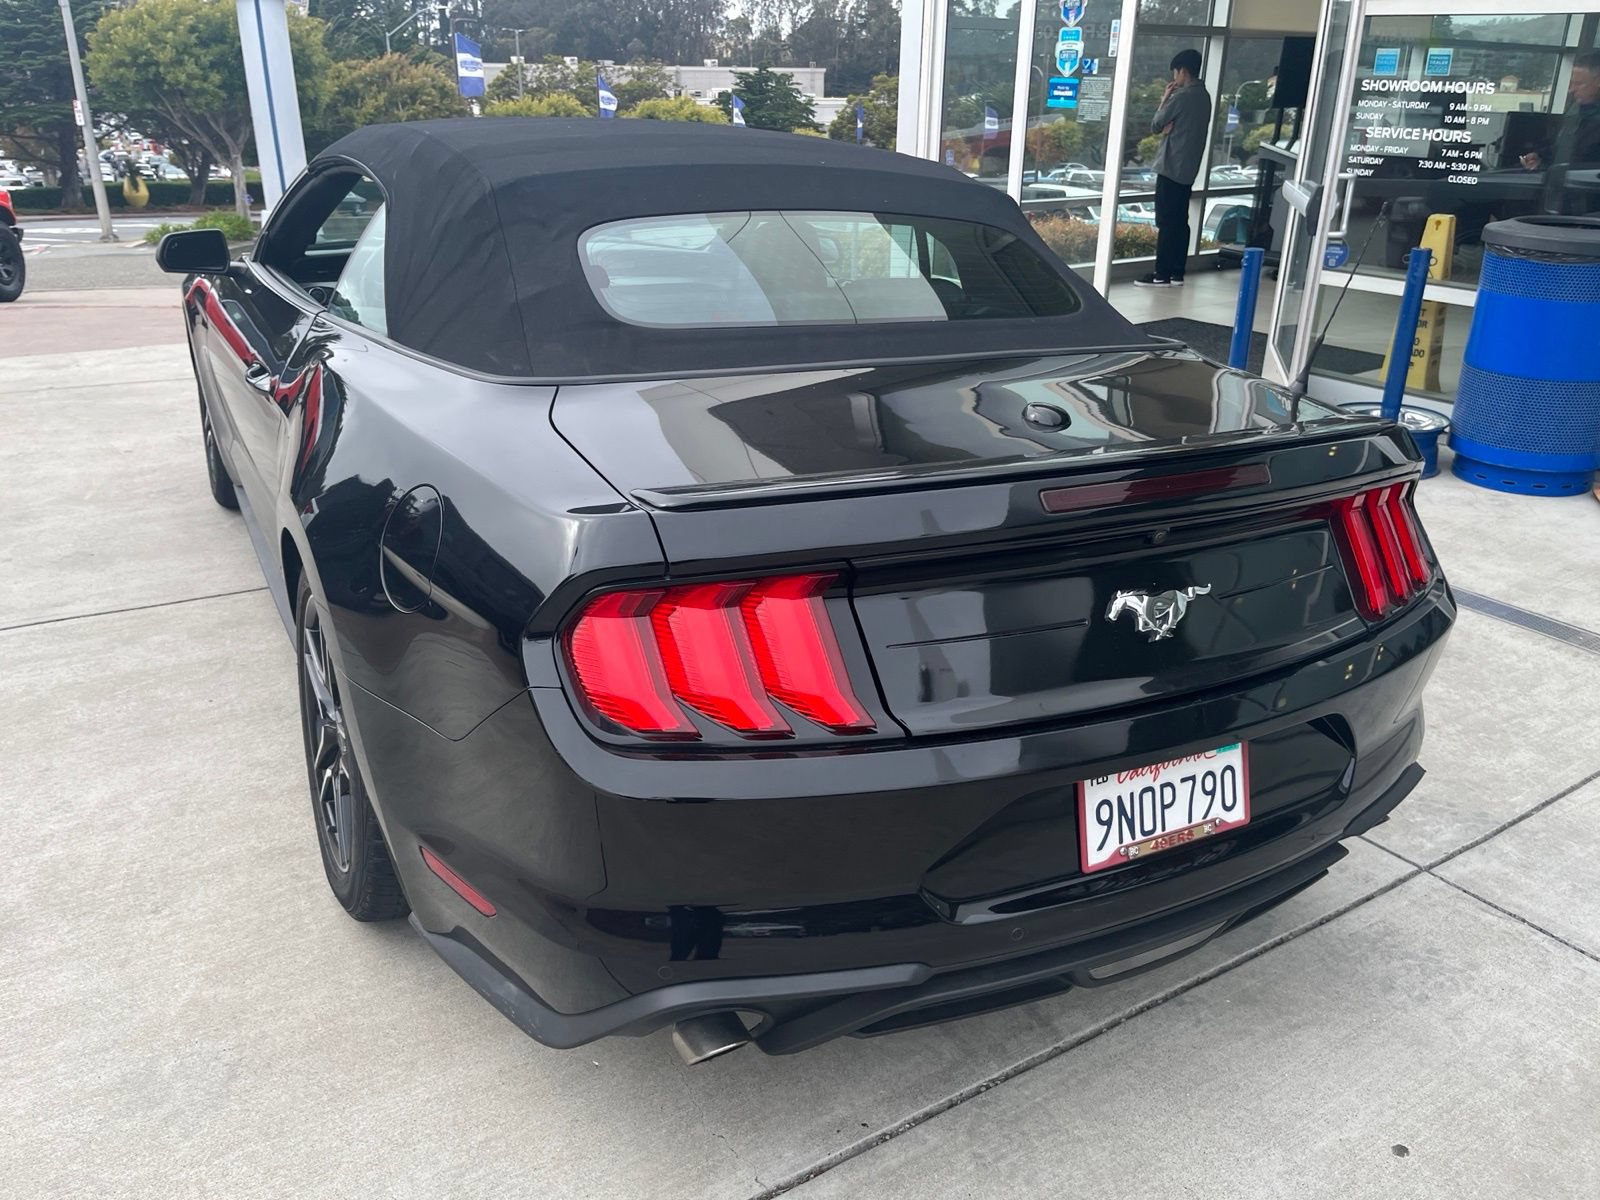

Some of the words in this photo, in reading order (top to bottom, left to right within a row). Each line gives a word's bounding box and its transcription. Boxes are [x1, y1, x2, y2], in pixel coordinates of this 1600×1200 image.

[1361, 79, 1441, 93] SHOWROOM
[1445, 82, 1495, 95] HOURS
[1358, 100, 1387, 108] MONDAY
[1392, 101, 1430, 109] SATURDAY
[1449, 103, 1454, 111] 9
[1455, 103, 1468, 111] AM
[1480, 104, 1492, 112] PM
[1355, 112, 1383, 120] SUNDAY
[1444, 115, 1451, 123] 10
[1453, 115, 1465, 124] AM
[1470, 117, 1476, 125] 8
[1477, 117, 1490, 125] PM
[1365, 126, 1420, 140] SERVICE
[1422, 128, 1472, 143] HOURS
[1350, 144, 1379, 152] MONDAY
[1384, 145, 1408, 154] FRIDAY
[1441, 149, 1446, 157] 7
[1447, 149, 1459, 158] AM
[1470, 151, 1482, 160] PM
[1348, 156, 1384, 165] SATURDAY
[1418, 160, 1433, 168] 7:30
[1433, 161, 1446, 170] AM
[1451, 162, 1467, 171] 5:30
[1468, 163, 1480, 172] PM
[1346, 168, 1374, 176] SUNDAY
[1447, 175, 1478, 185] CLOSED
[1096, 764, 1237, 851] 9NOP790
[1150, 829, 1195, 850] 49ERS
